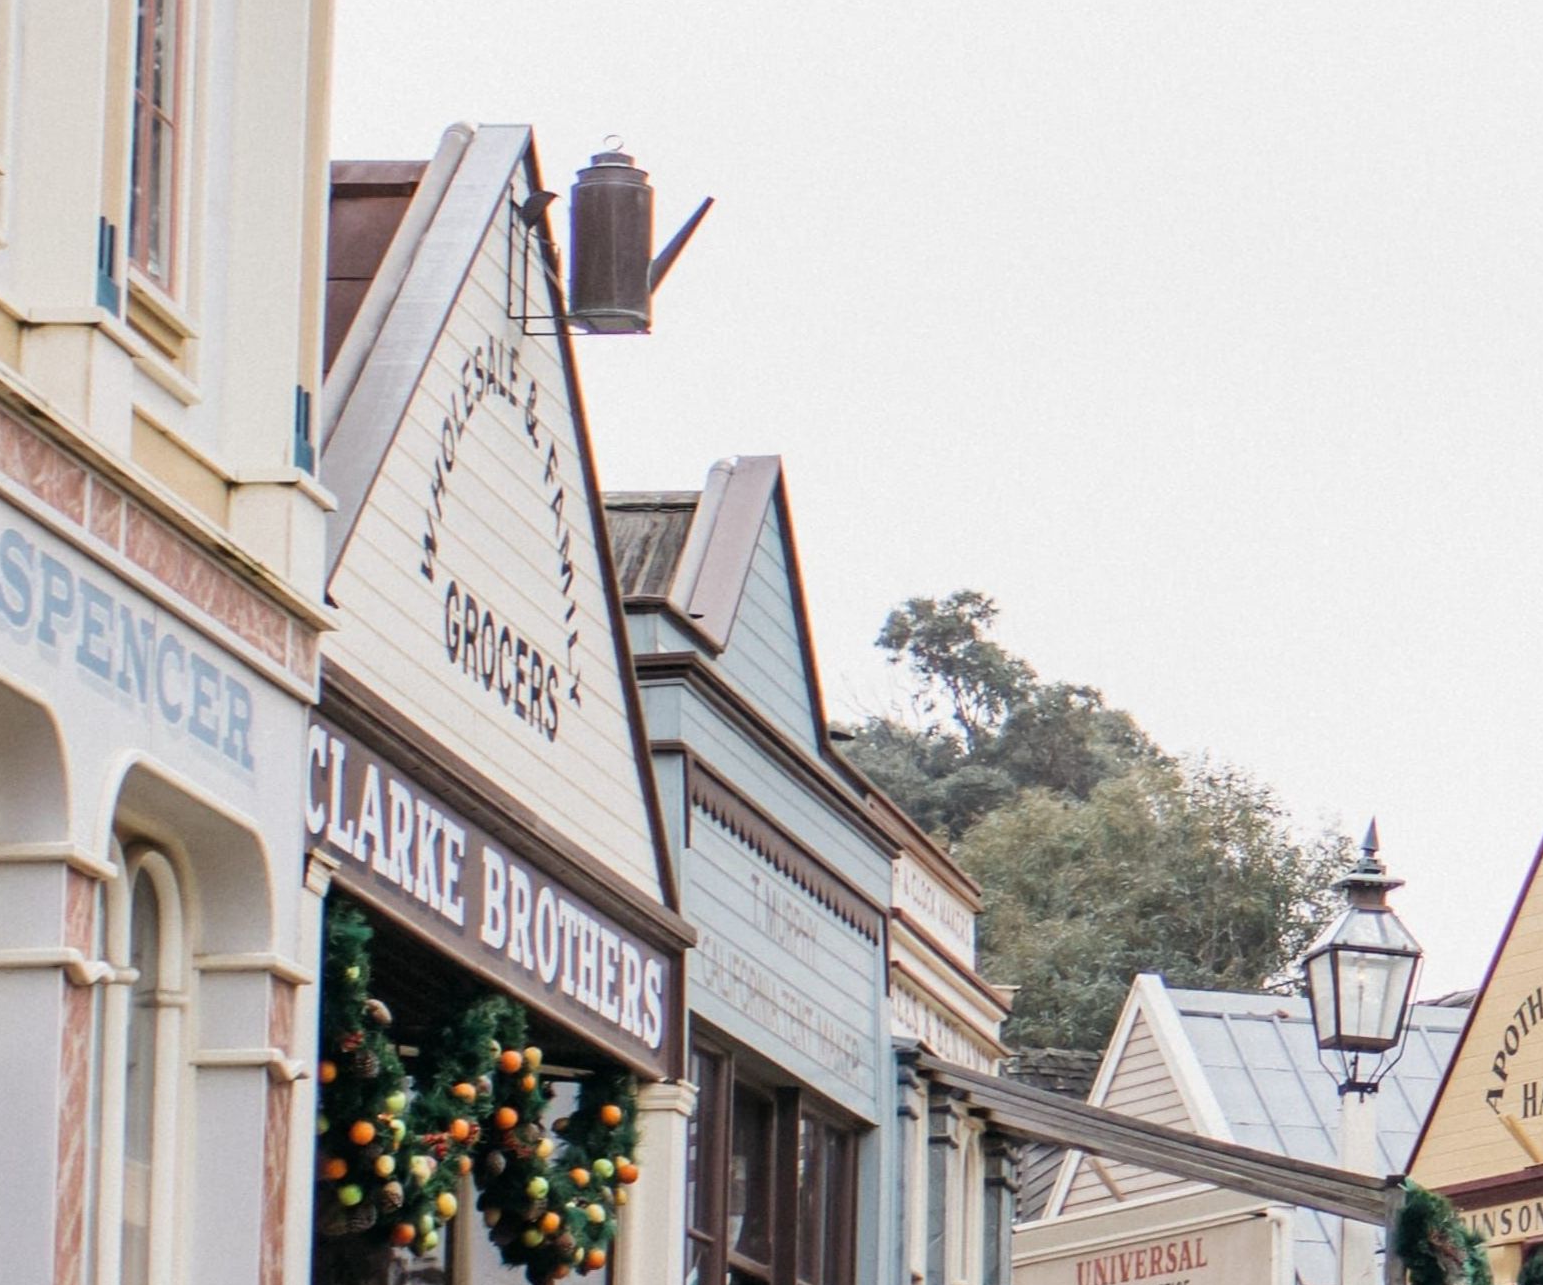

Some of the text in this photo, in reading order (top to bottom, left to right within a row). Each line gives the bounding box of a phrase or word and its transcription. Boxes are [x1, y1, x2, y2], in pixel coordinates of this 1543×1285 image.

[421, 335, 582, 708] WHOLESALE & FAMILY
[445, 580, 559, 743] GROCERS
[306, 724, 663, 1050] CLARKE BROTHERS
